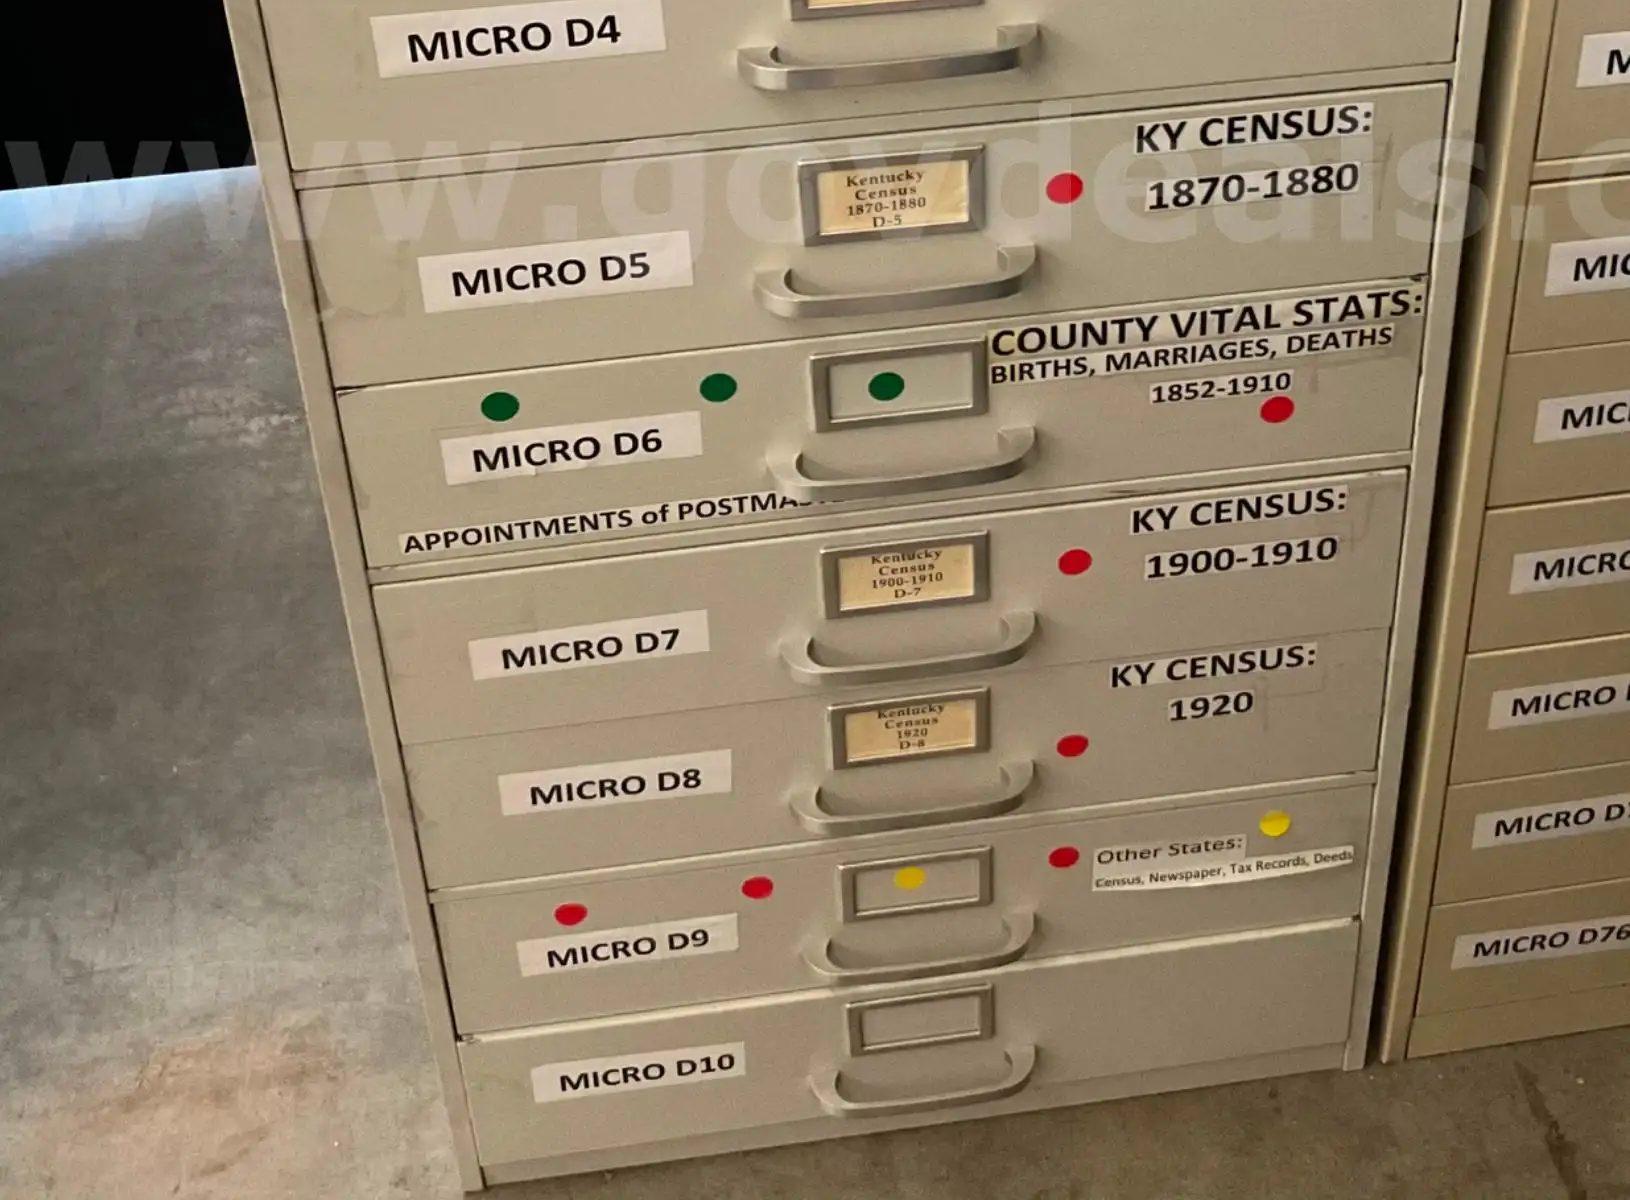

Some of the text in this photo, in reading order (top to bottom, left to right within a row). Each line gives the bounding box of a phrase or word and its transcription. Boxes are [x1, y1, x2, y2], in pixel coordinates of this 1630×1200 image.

[408, 15, 621, 62] MICRO D4
[1137, 106, 1371, 153] KY CENSUS:
[847, 169, 925, 187] Kentucky
[855, 186, 917, 201] Census
[1149, 164, 1358, 210] 1870-1880
[847, 196, 927, 216] 1870-1880
[872, 214, 902, 228] D-5
[452, 253, 649, 296] MICRO D5
[992, 290, 1422, 357] COUNTY VITAL STATS:
[991, 327, 1392, 384] BIRTHS, MARRIAGES, DEATHS
[1151, 371, 1292, 404] 1852-1910
[473, 429, 662, 472] MICRO D6
[1134, 489, 1345, 533] KY CENSUS:
[404, 509, 633, 553] APPOINTMENTS
[642, 504, 668, 524] of
[871, 549, 943, 565] Kentucky
[878, 562, 936, 577] Census
[1148, 537, 1337, 578] 1900-1910
[872, 572, 944, 589] 1900-1910
[894, 587, 922, 599] D-7
[502, 629, 679, 669] MICRO D7
[1112, 646, 1315, 688] KY CENSUS:
[877, 703, 945, 719] Kentucky
[1171, 692, 1253, 721] 1920
[1512, 687, 1616, 716] MICRO
[884, 716, 940, 730] Census
[897, 727, 929, 739] 1920
[531, 769, 701, 805] MICRO D8
[1495, 801, 1630, 836] MICRO D
[1098, 839, 1242, 864] Other States:
[1095, 874, 1146, 889] Census,
[1148, 865, 1227, 886] Newspaper,
[1230, 863, 1253, 875] Tax
[1255, 855, 1310, 872] Records,
[548, 929, 708, 968] MICRO D9
[1474, 924, 1630, 957] MICRO D76
[560, 1054, 734, 1091] MICRO D10
